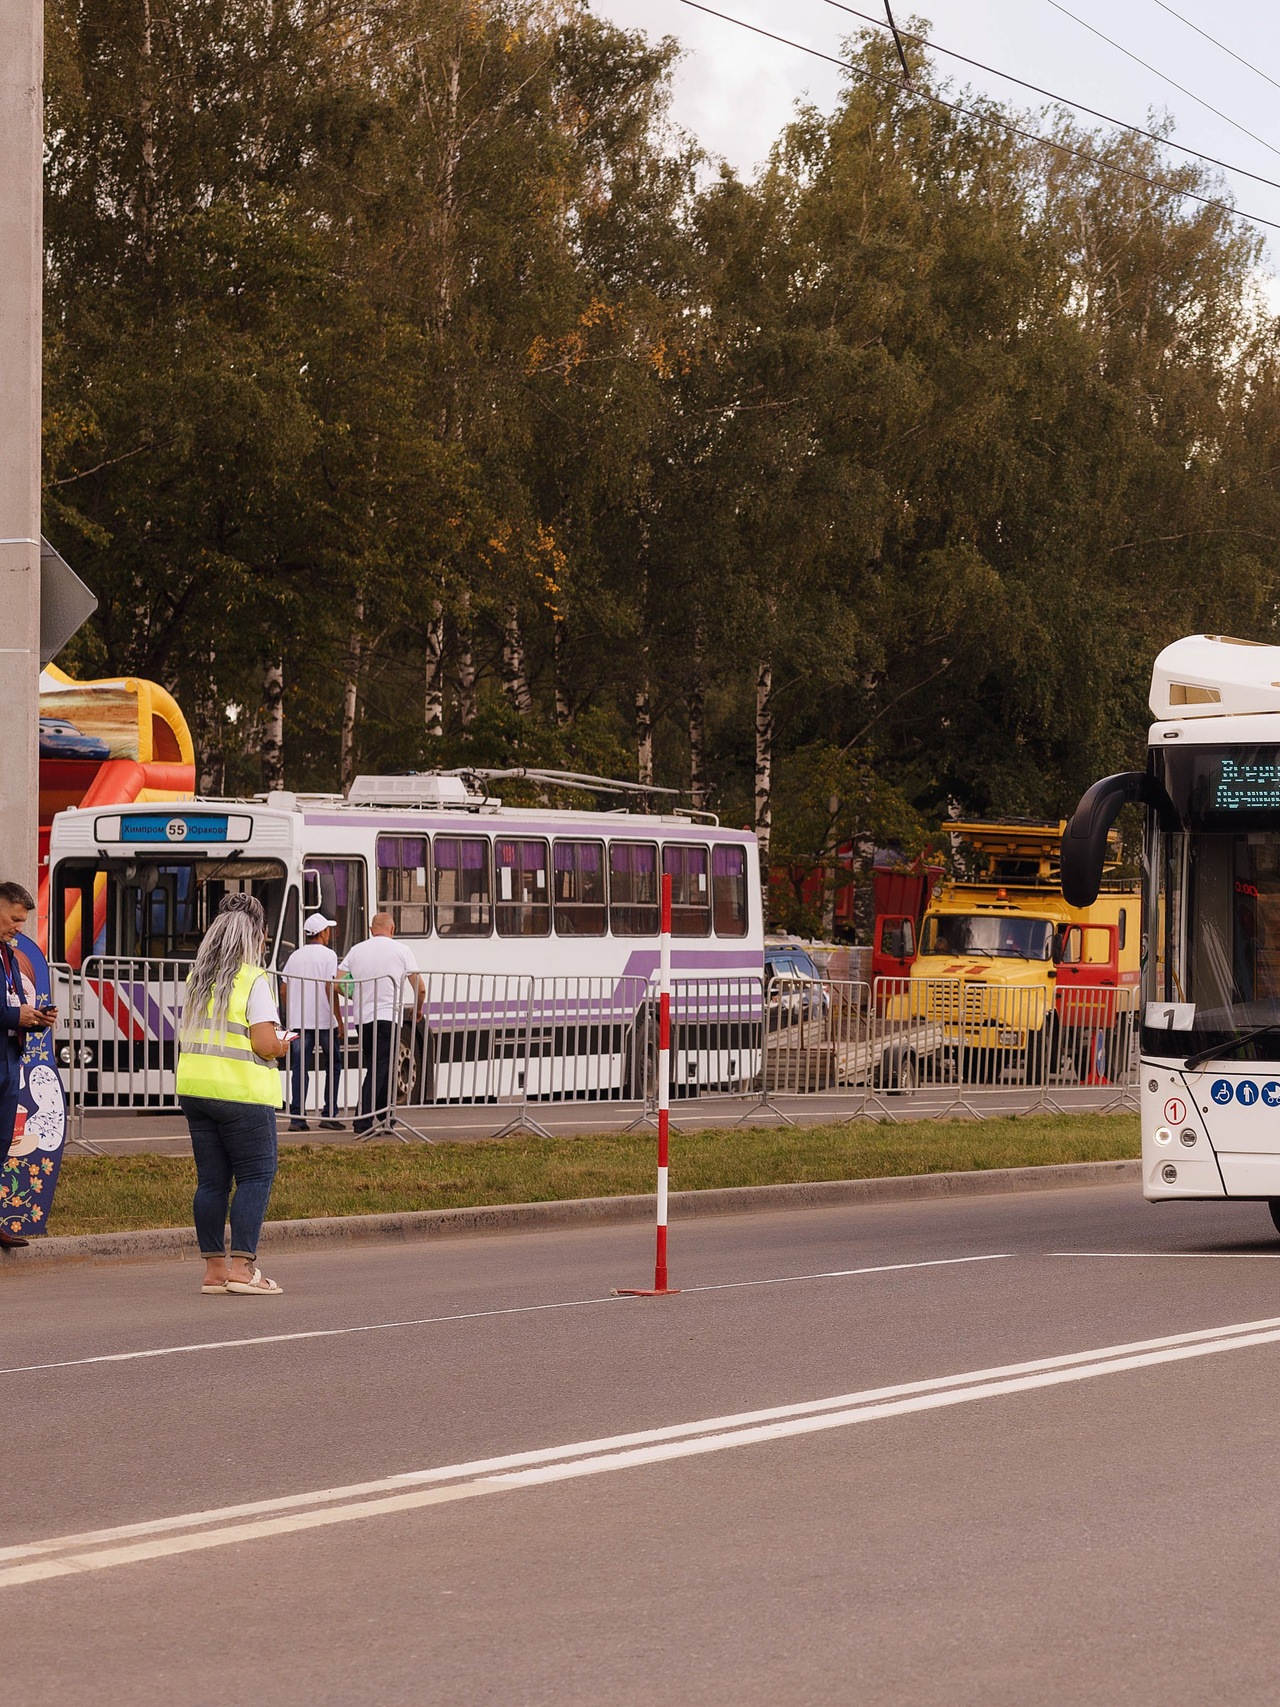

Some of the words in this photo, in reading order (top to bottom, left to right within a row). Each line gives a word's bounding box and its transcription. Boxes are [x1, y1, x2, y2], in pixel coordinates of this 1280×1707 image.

[124, 825, 164, 834] Химпром
[168, 825, 185, 835] 55
[1163, 1009, 1175, 1030] 1
